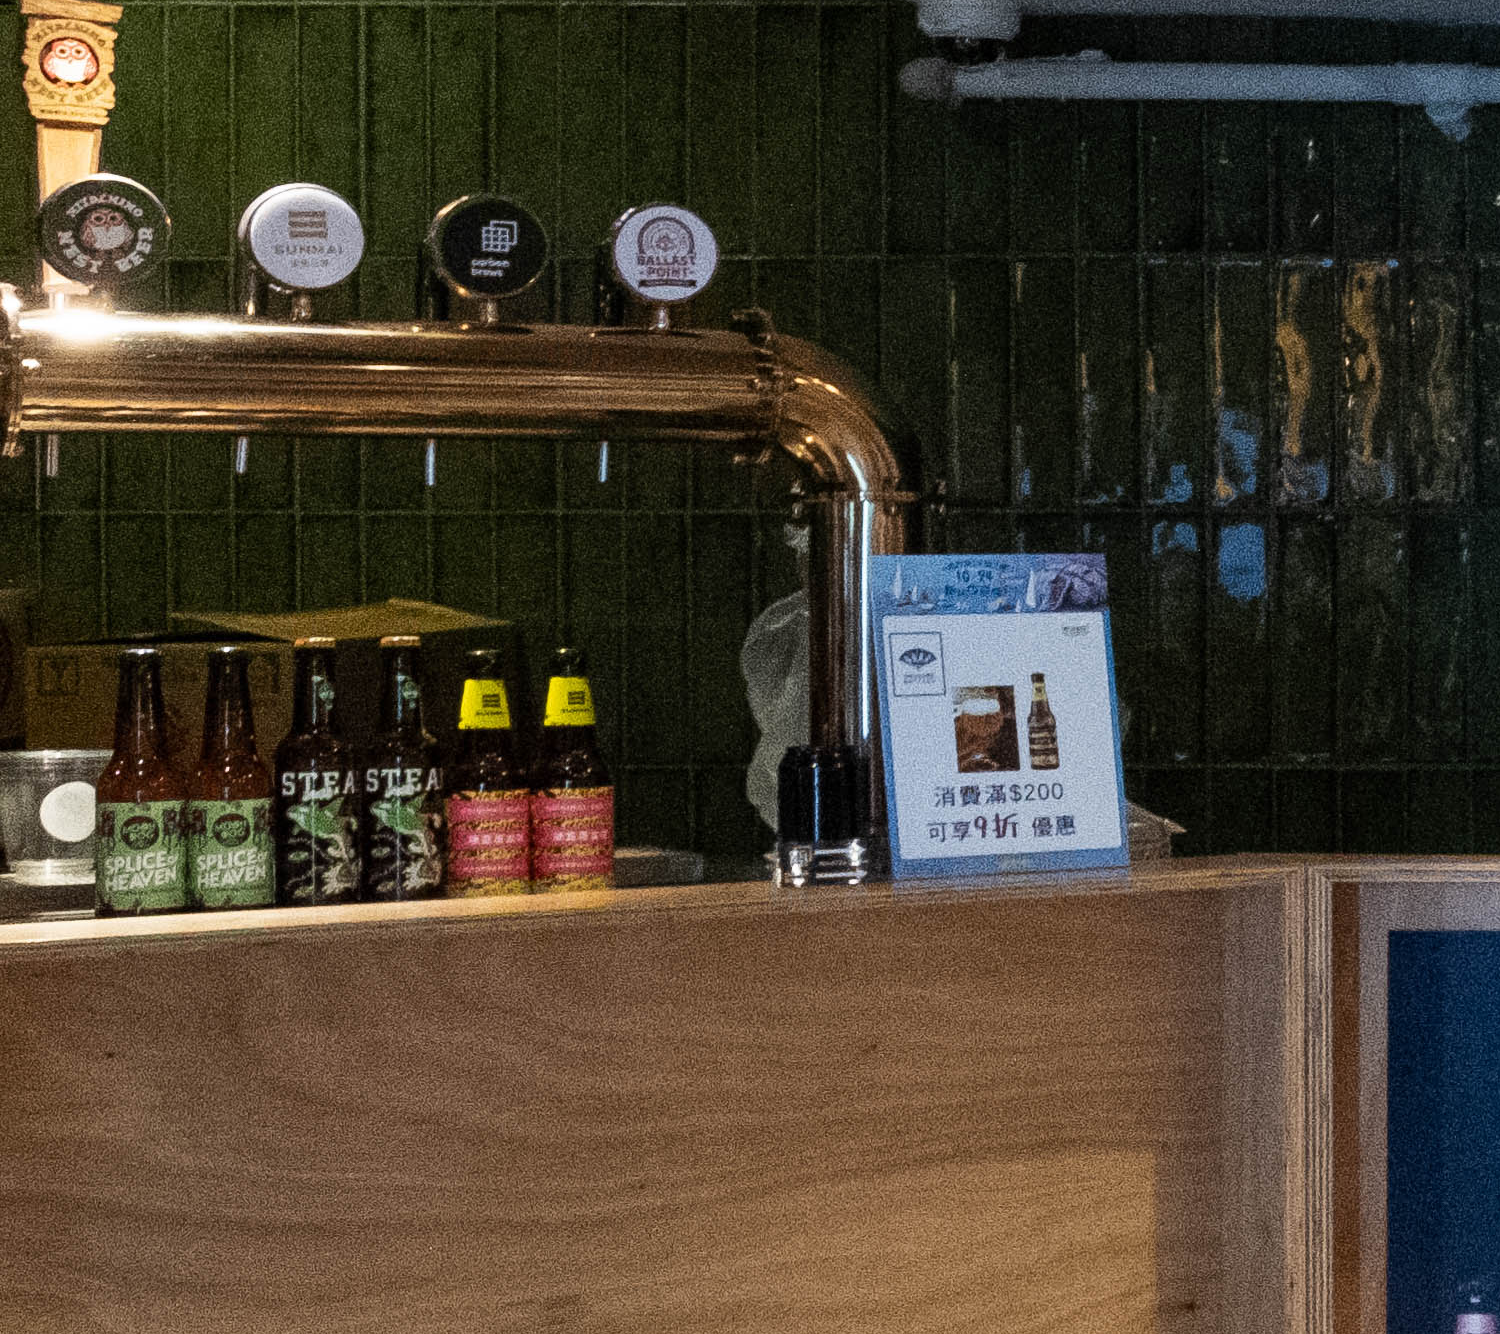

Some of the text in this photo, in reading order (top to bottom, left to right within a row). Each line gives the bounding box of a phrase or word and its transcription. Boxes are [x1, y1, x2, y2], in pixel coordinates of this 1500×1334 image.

[638, 256, 696, 265] BALLAST
[934, 783, 1064, 808] 消費滿$200
[105, 869, 177, 890] HEAVEN
[199, 868, 267, 887] HEAVEN
